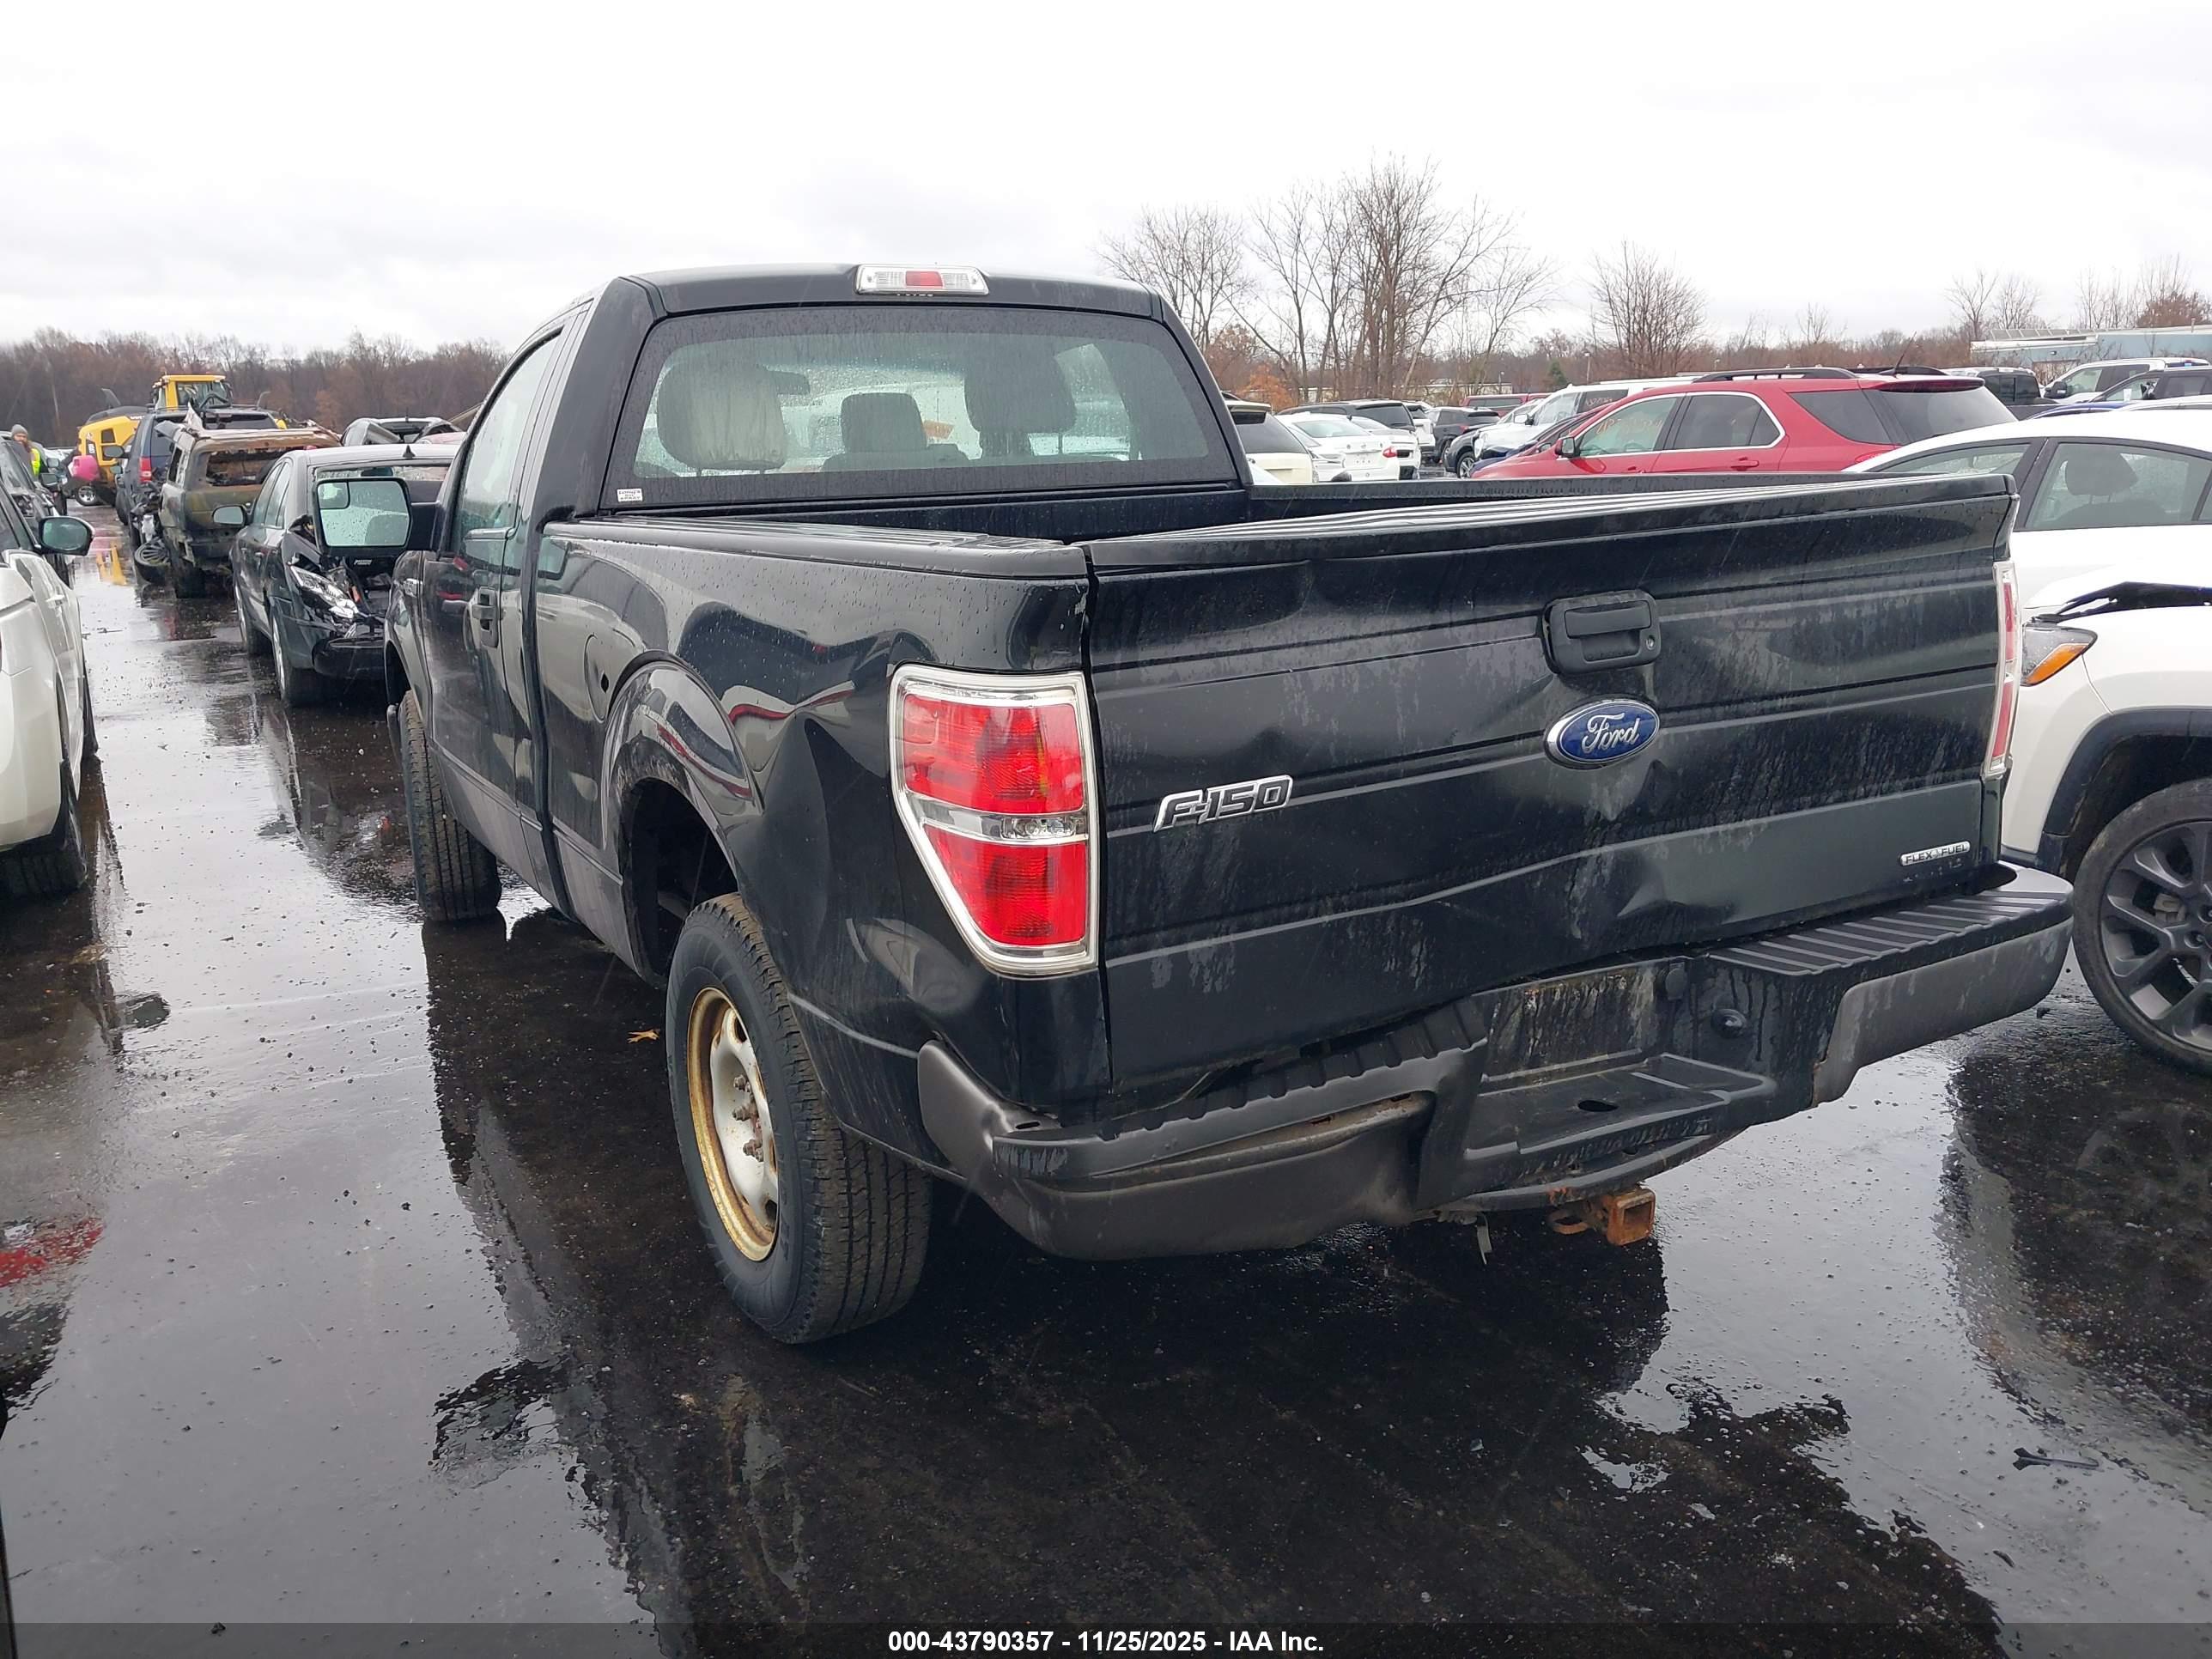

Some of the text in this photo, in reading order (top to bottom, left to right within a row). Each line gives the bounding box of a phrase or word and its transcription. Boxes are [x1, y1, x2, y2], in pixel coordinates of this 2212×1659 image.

[1581, 712, 1640, 754] Ford
[1153, 775, 1293, 832] F-150
[1905, 843, 1968, 864] FLEX FUEL
